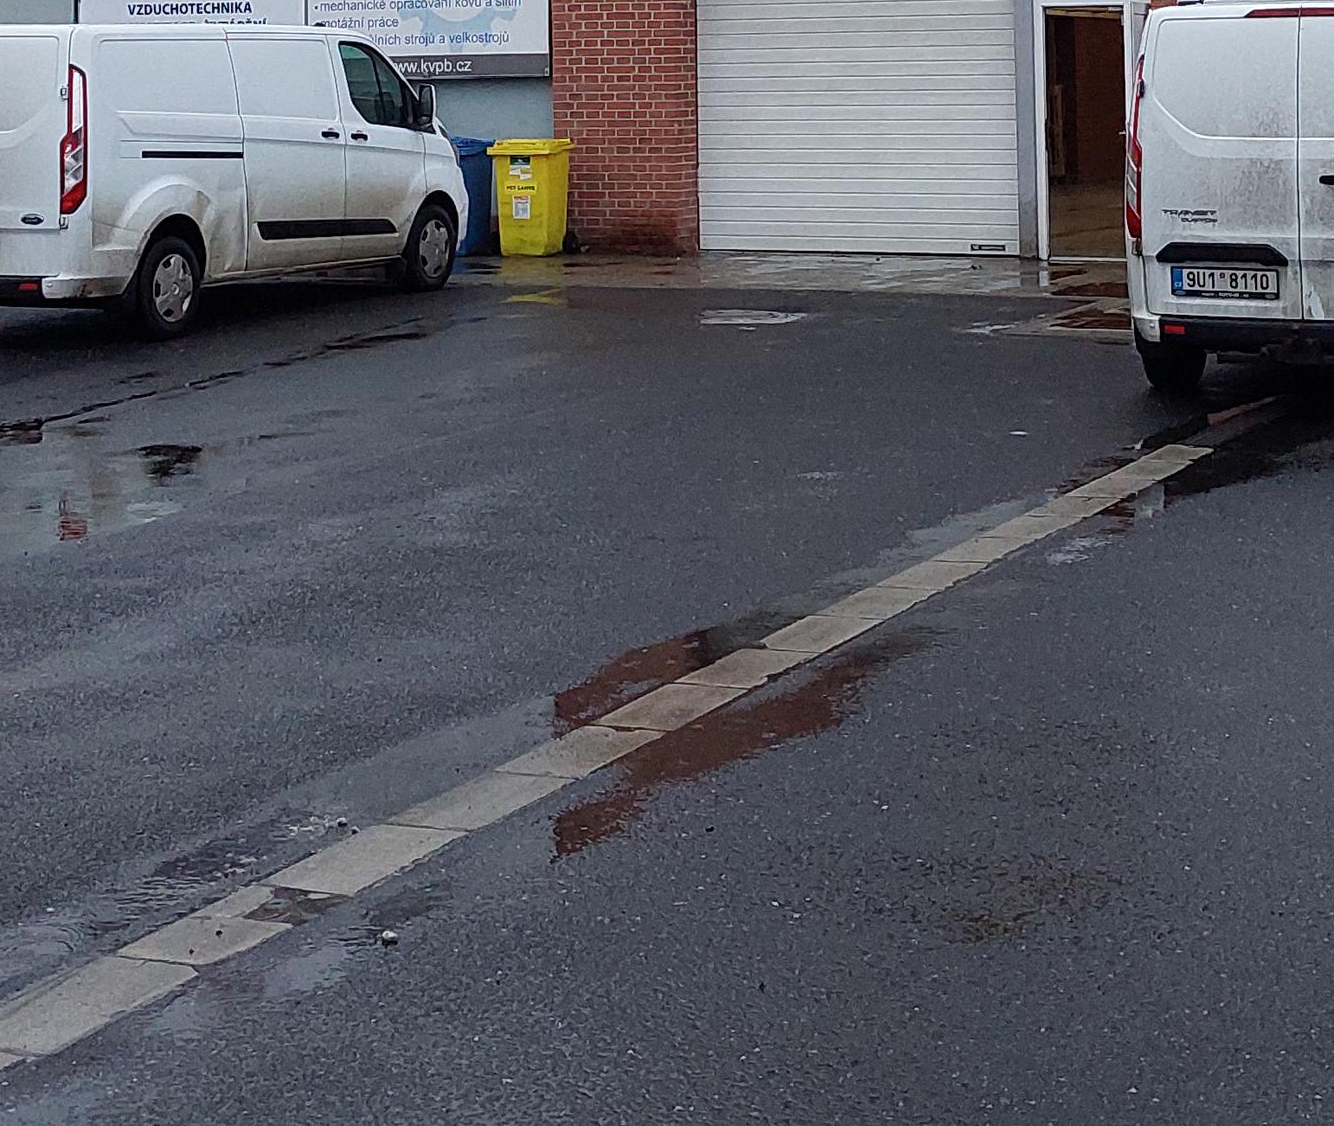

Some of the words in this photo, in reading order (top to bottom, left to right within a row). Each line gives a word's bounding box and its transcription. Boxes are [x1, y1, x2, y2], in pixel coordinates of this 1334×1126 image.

[128, 1, 252, 16] VZDUCHOTECHNIKA
[485, 0, 492, 7] a
[367, 16, 399, 32] práce
[403, 31, 436, 47] strojů
[438, 34, 446, 44] a
[449, 29, 509, 46] velkostrojů
[1187, 272, 1216, 289] 9U1
[1229, 273, 1269, 290] 8110
